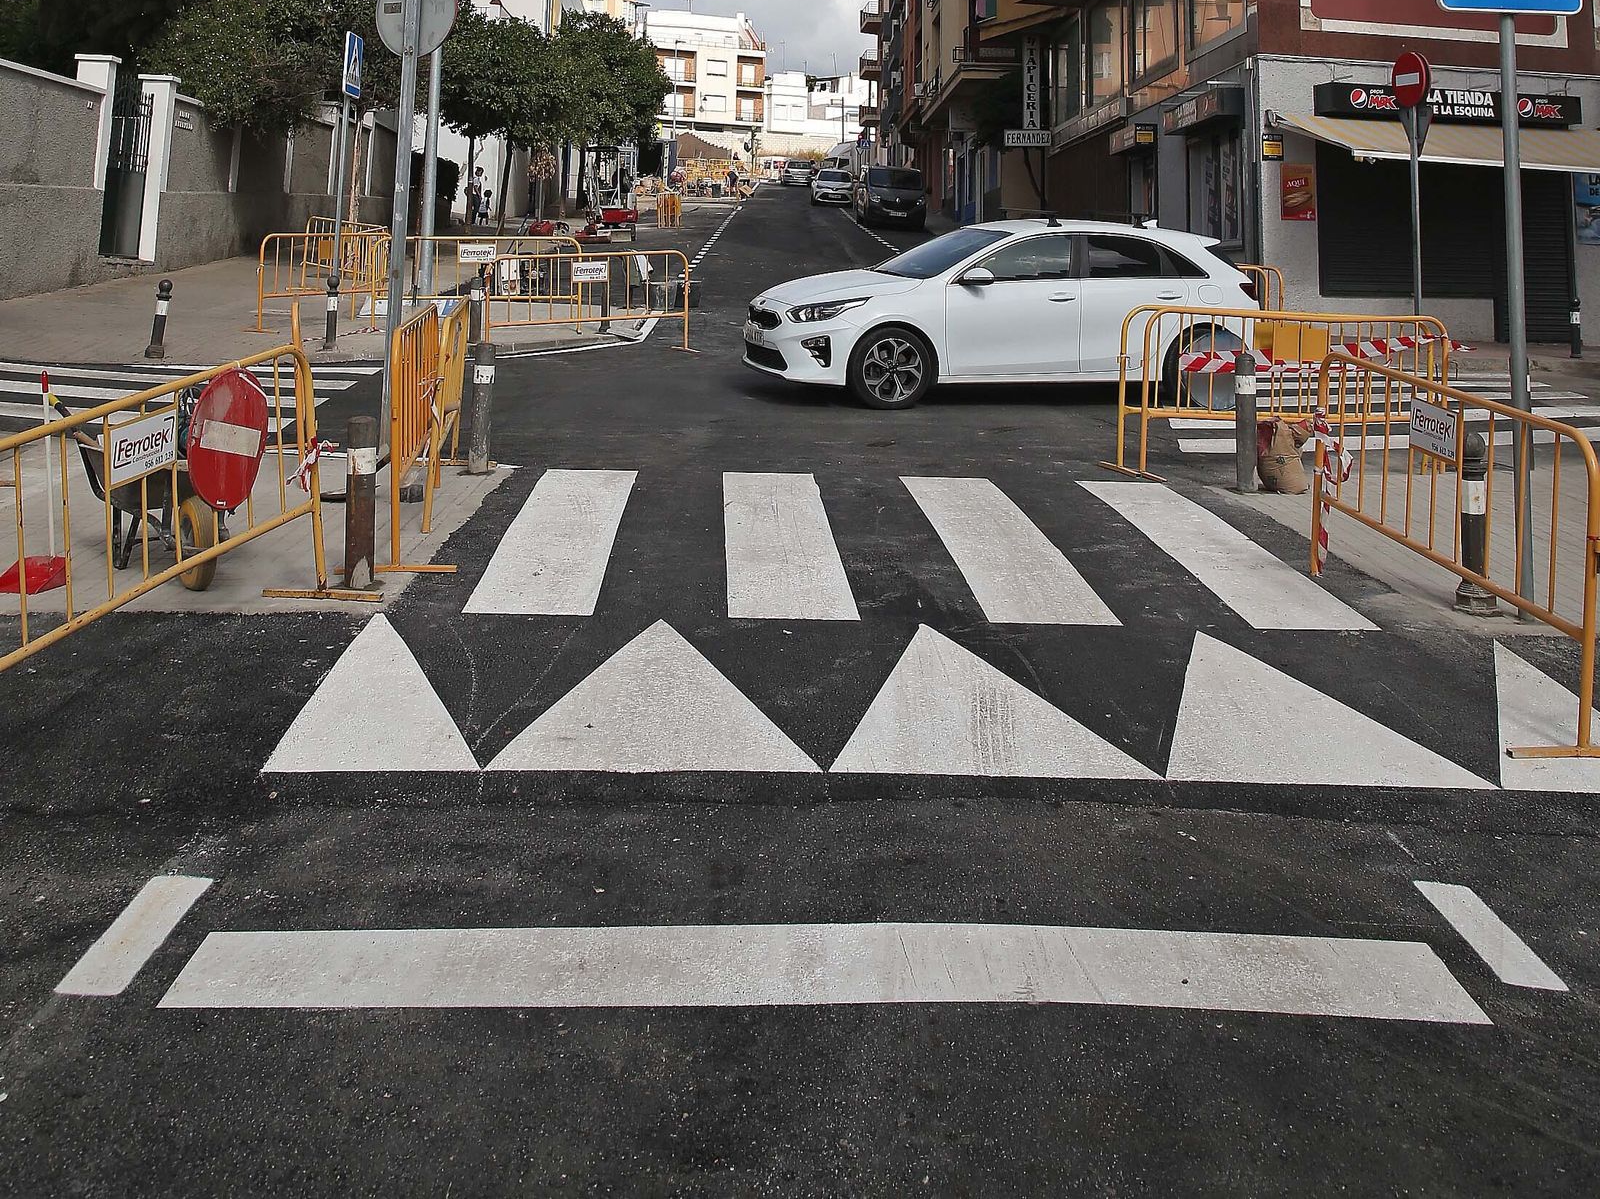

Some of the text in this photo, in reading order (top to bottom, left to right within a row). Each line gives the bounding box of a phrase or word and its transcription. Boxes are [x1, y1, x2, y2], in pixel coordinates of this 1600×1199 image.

[1026, 48, 1037, 128] TAPICERIA
[1426, 90, 1494, 106] LA TIENDA
[1441, 105, 1453, 115] LA
[1454, 106, 1495, 117] ESQUINA
[1006, 133, 1050, 144] FERNANDEZ
[463, 249, 492, 258] Ferrotek
[576, 267, 604, 275] Ferrotek
[1415, 407, 1451, 442] Ferrotek
[117, 427, 170, 461] Ferrotek
[145, 459, 154, 470] 956
